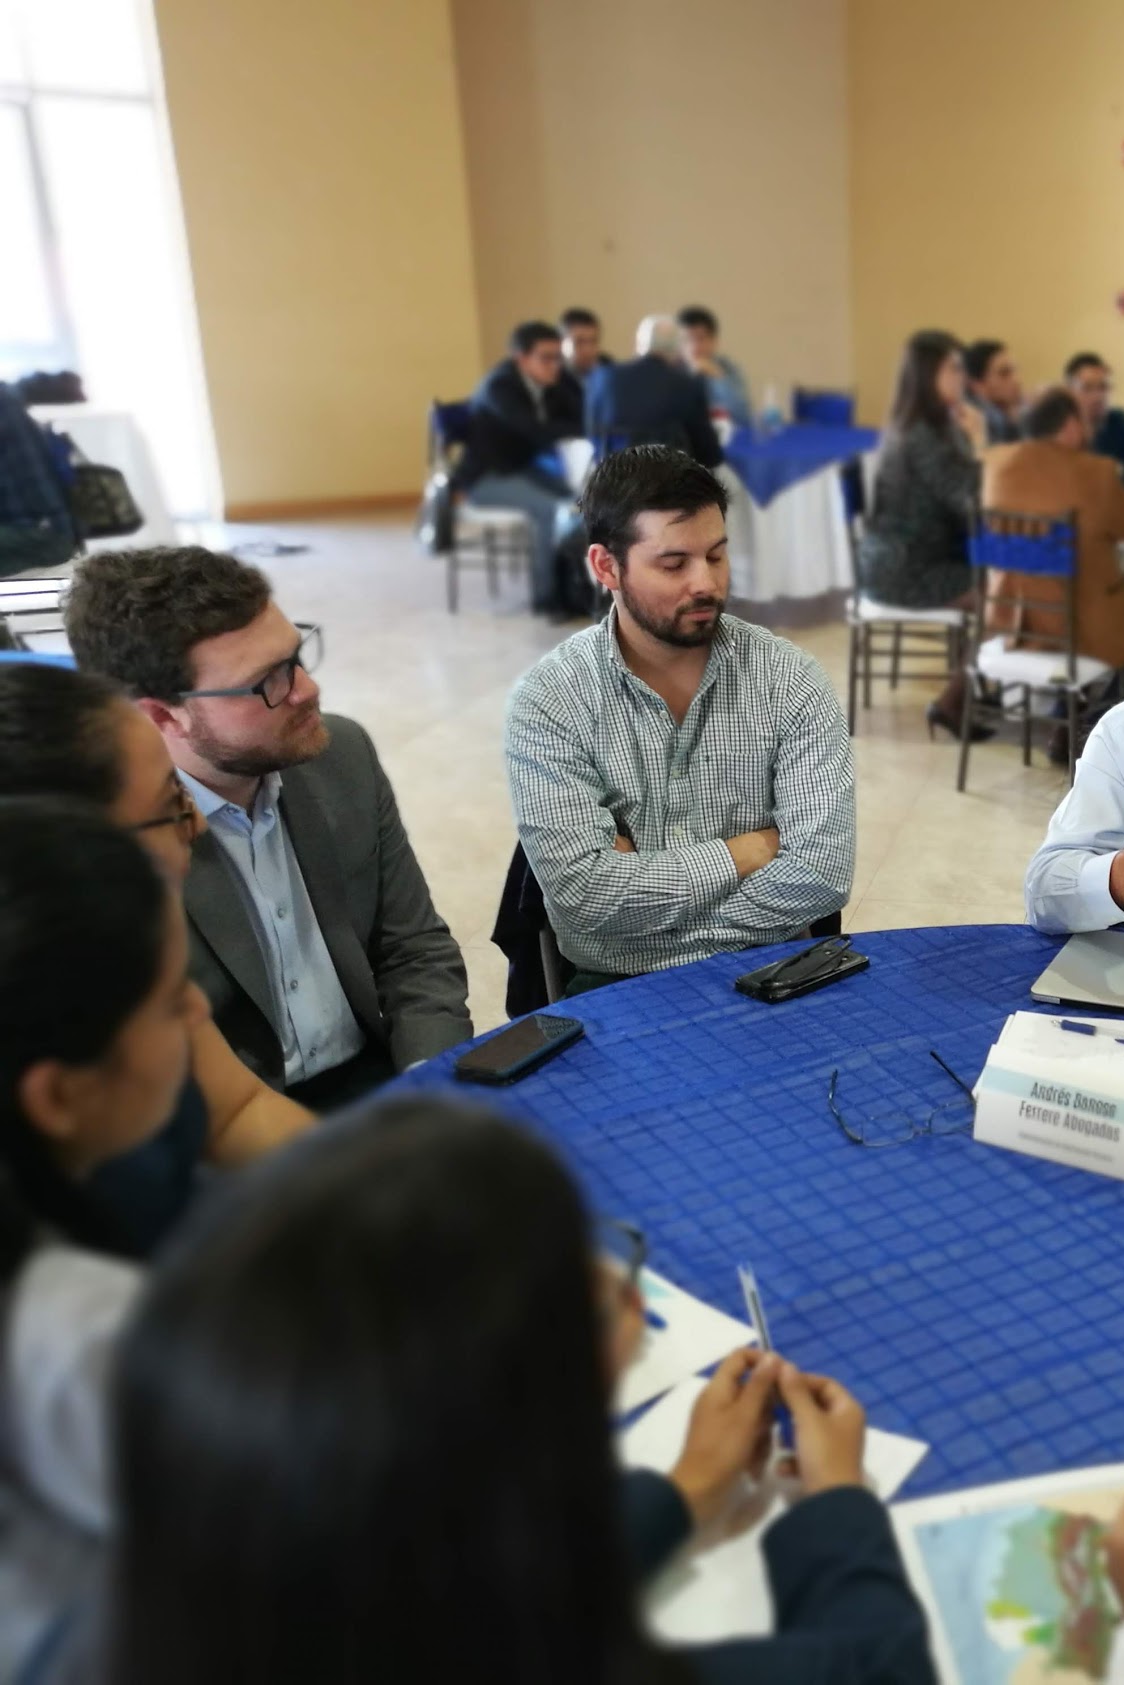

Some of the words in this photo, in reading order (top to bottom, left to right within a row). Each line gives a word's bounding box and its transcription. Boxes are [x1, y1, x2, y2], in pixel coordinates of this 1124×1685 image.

[1030, 1081, 1071, 1107] Andrés
[1019, 1100, 1060, 1126] Ferrere
[1063, 1112, 1120, 1142] Abogados
